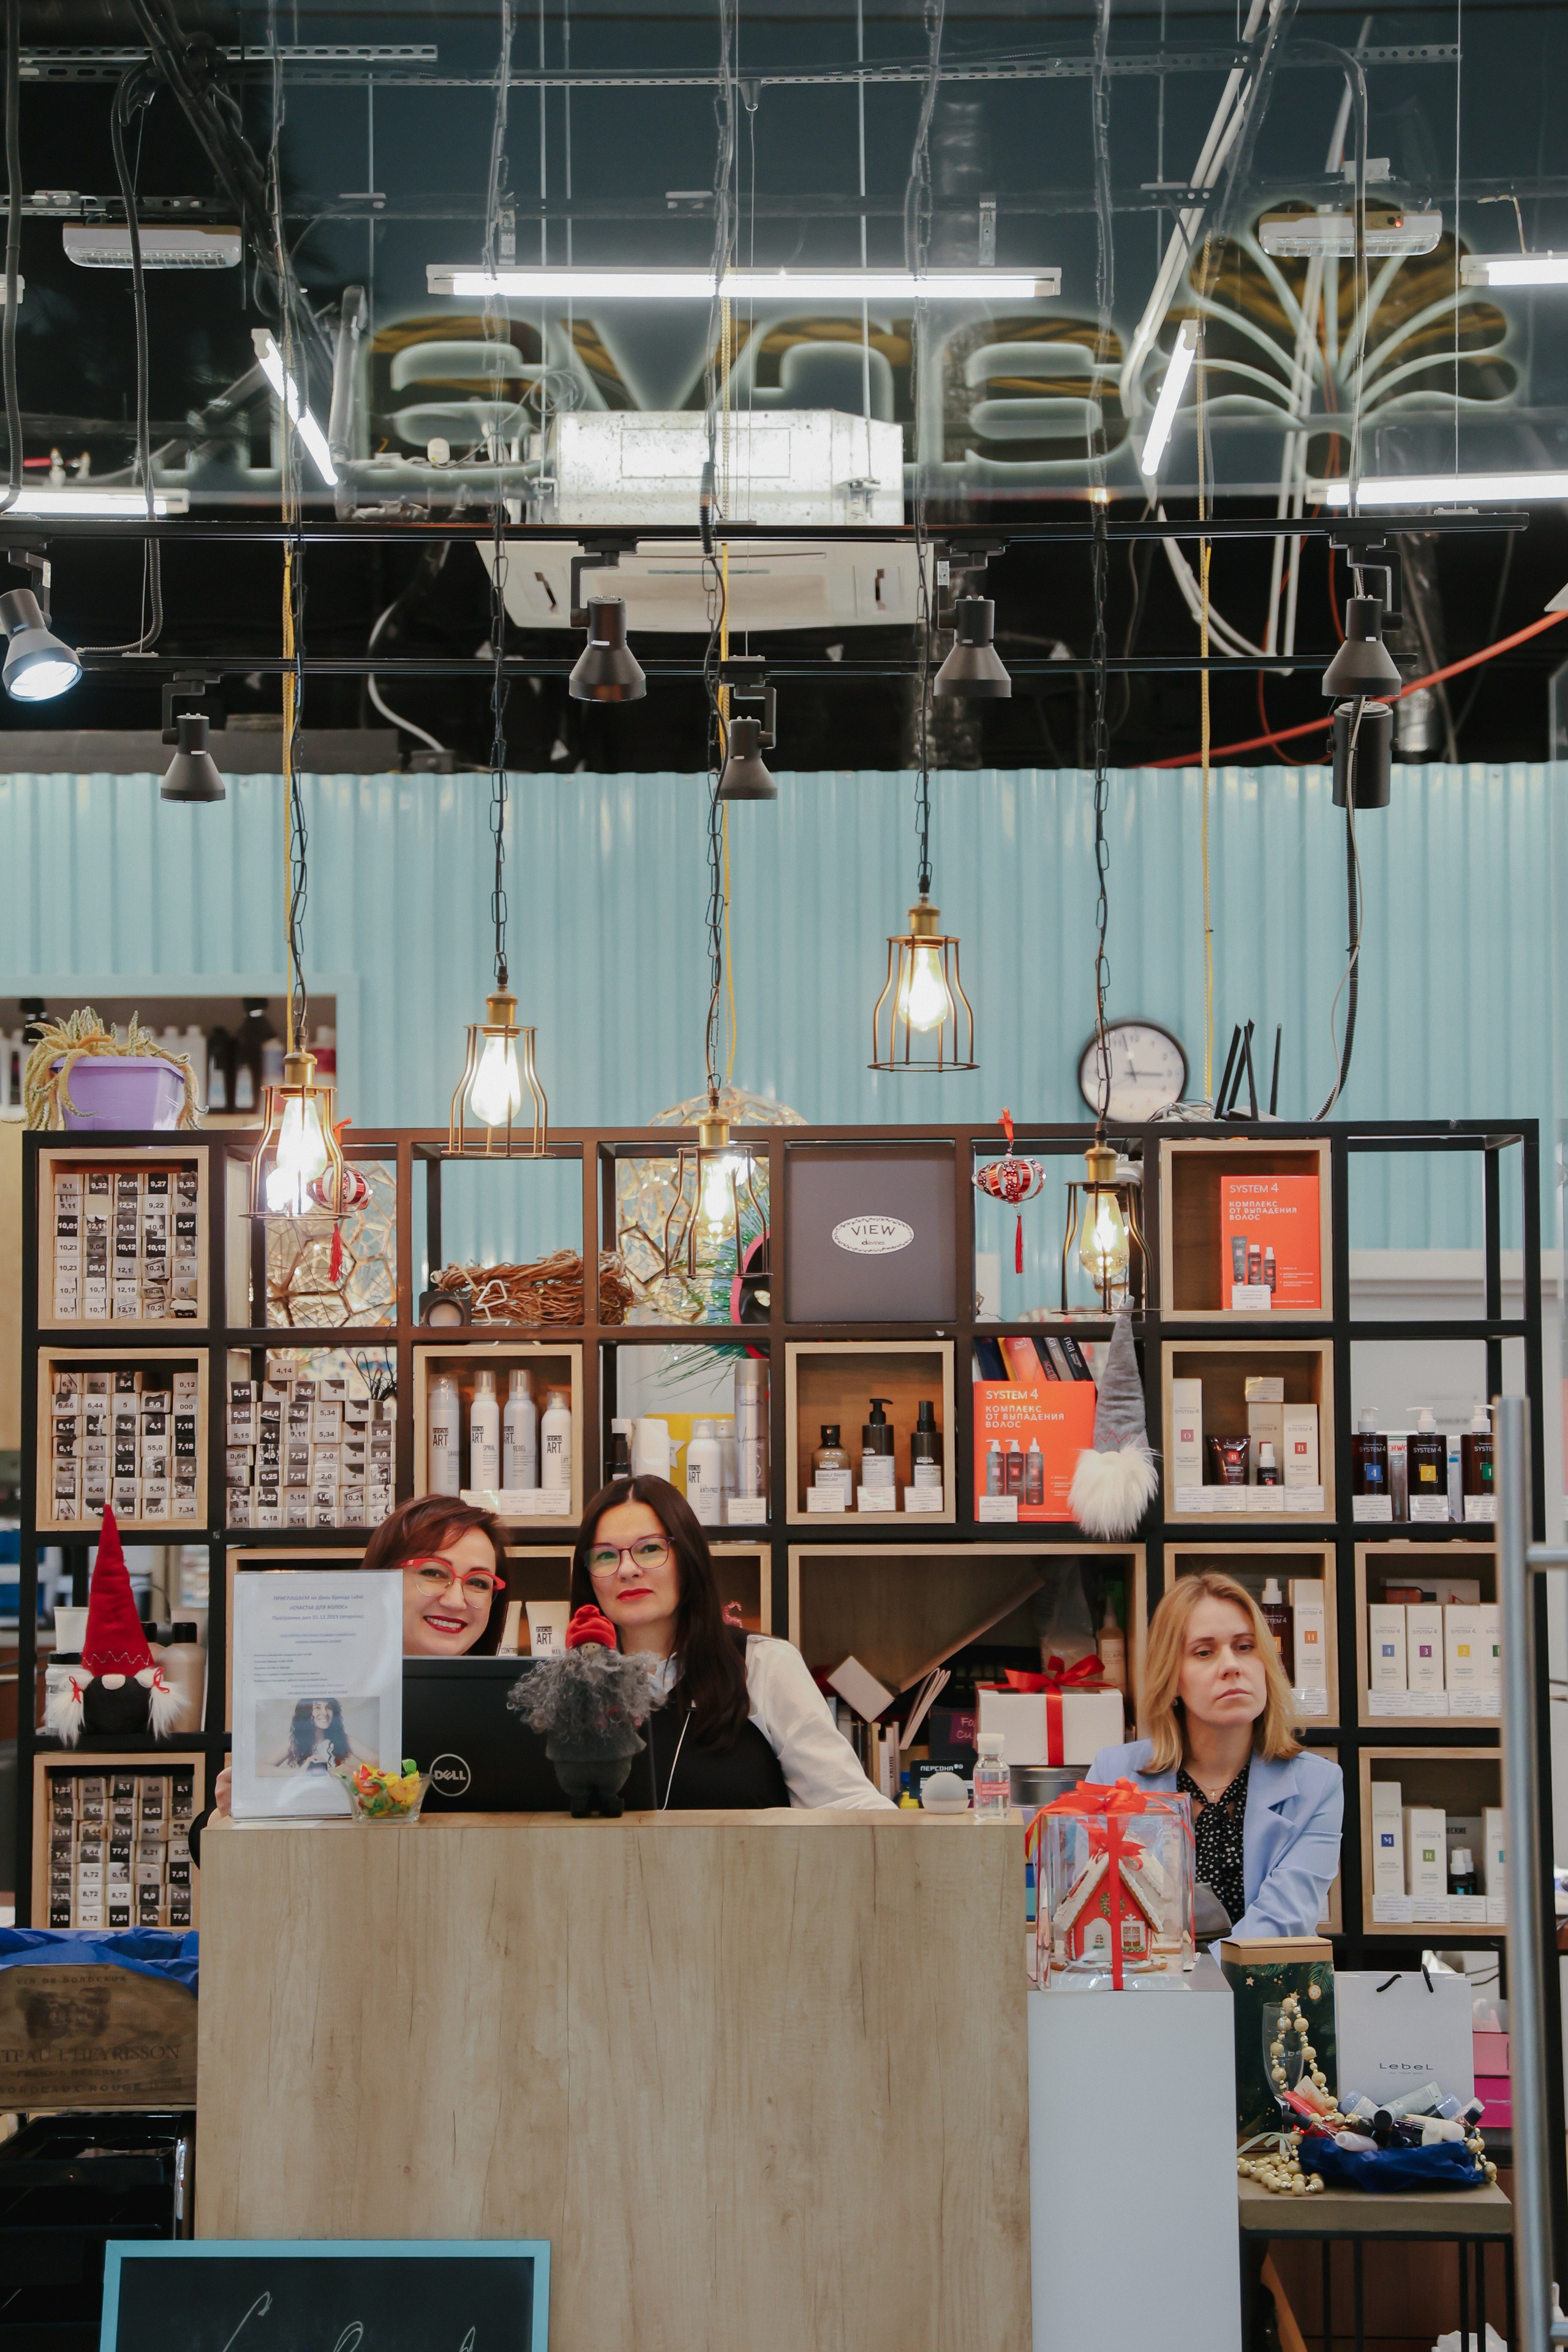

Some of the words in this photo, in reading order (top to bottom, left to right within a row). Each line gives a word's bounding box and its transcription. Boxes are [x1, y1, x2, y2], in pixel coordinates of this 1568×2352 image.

[1230, 1185, 1268, 1193] SYSTEM
[1271, 1183, 1279, 1193] 4
[851, 1225, 895, 1235] VIEW
[1064, 1336, 1075, 1352] TIGI
[986, 1390, 1027, 1400] SYSTEM
[1030, 1389, 1039, 1400] 4
[433, 1434, 448, 1446] ART
[472, 1433, 484, 1444] ART
[547, 1442, 562, 1453] ART
[688, 1472, 701, 1483] ART
[537, 1633, 552, 1645] ART
[434, 1770, 466, 1781] DELL
